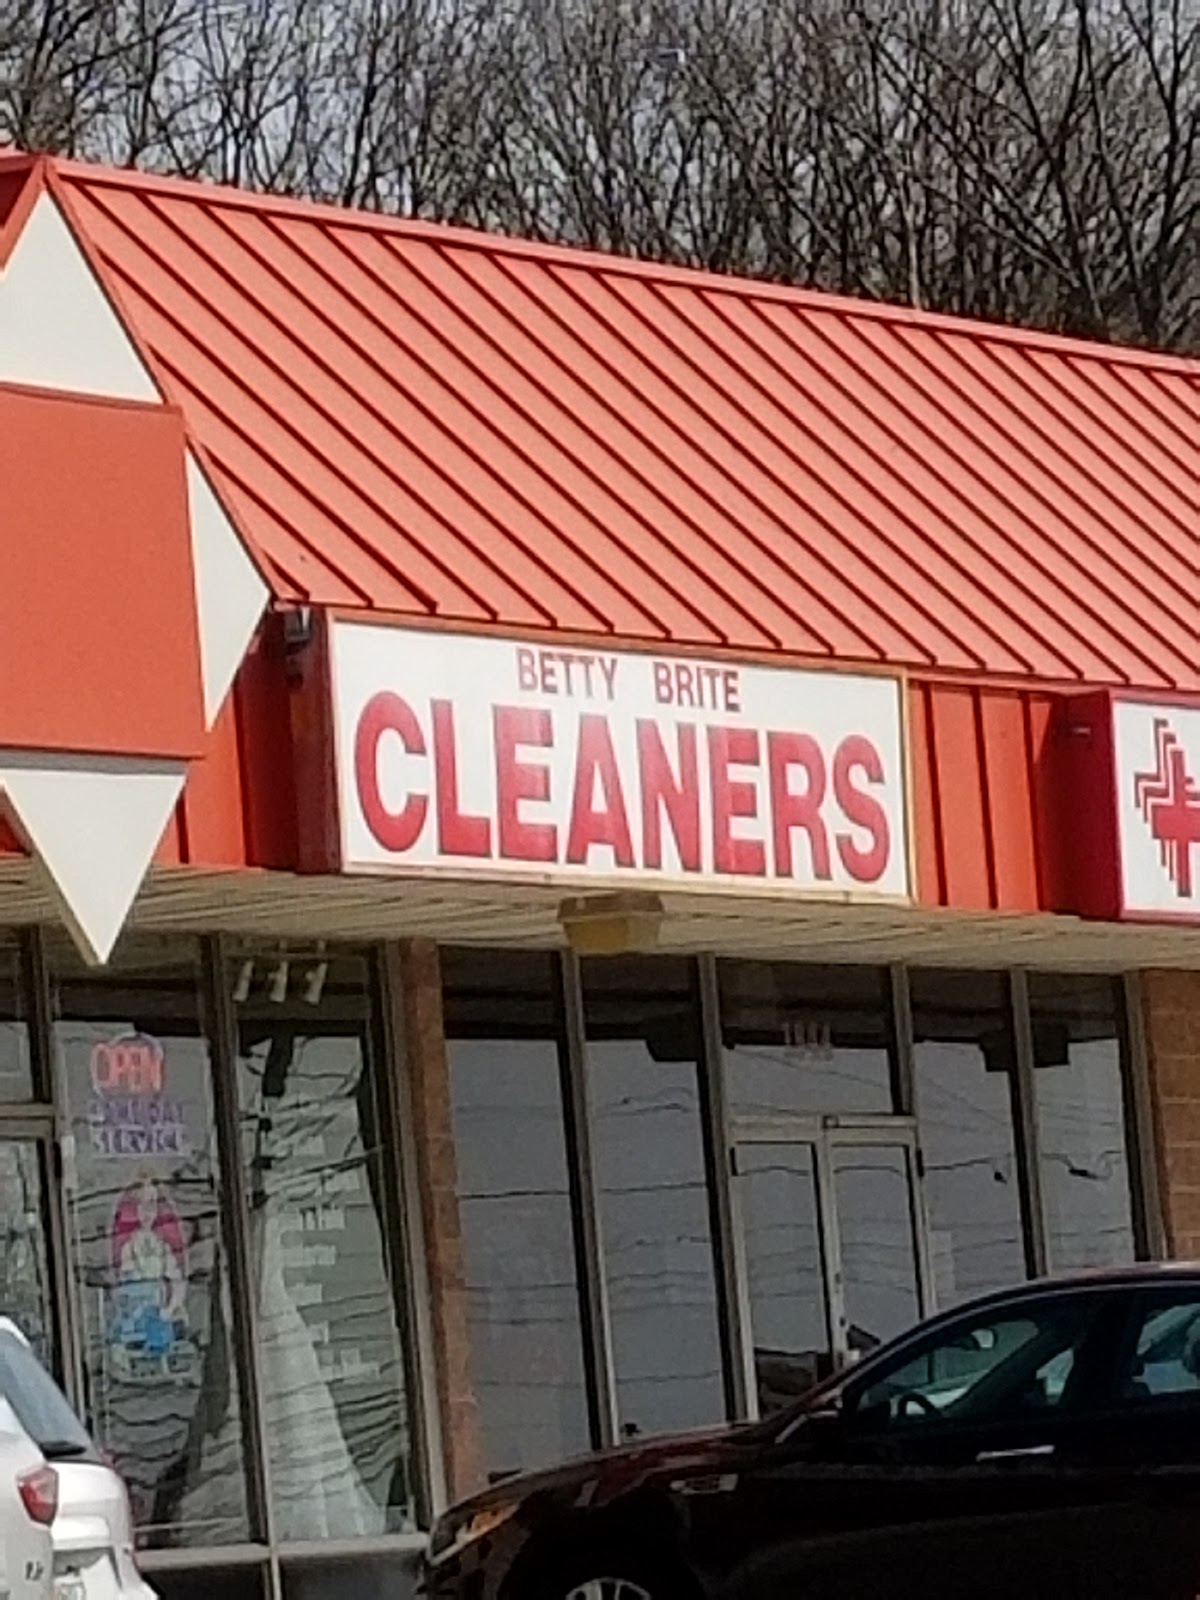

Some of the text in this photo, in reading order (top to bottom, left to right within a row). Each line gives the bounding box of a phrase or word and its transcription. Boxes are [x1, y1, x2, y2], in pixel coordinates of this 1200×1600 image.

[516, 648, 740, 712] BETTY BRITE
[354, 690, 889, 882] CLEANERS
